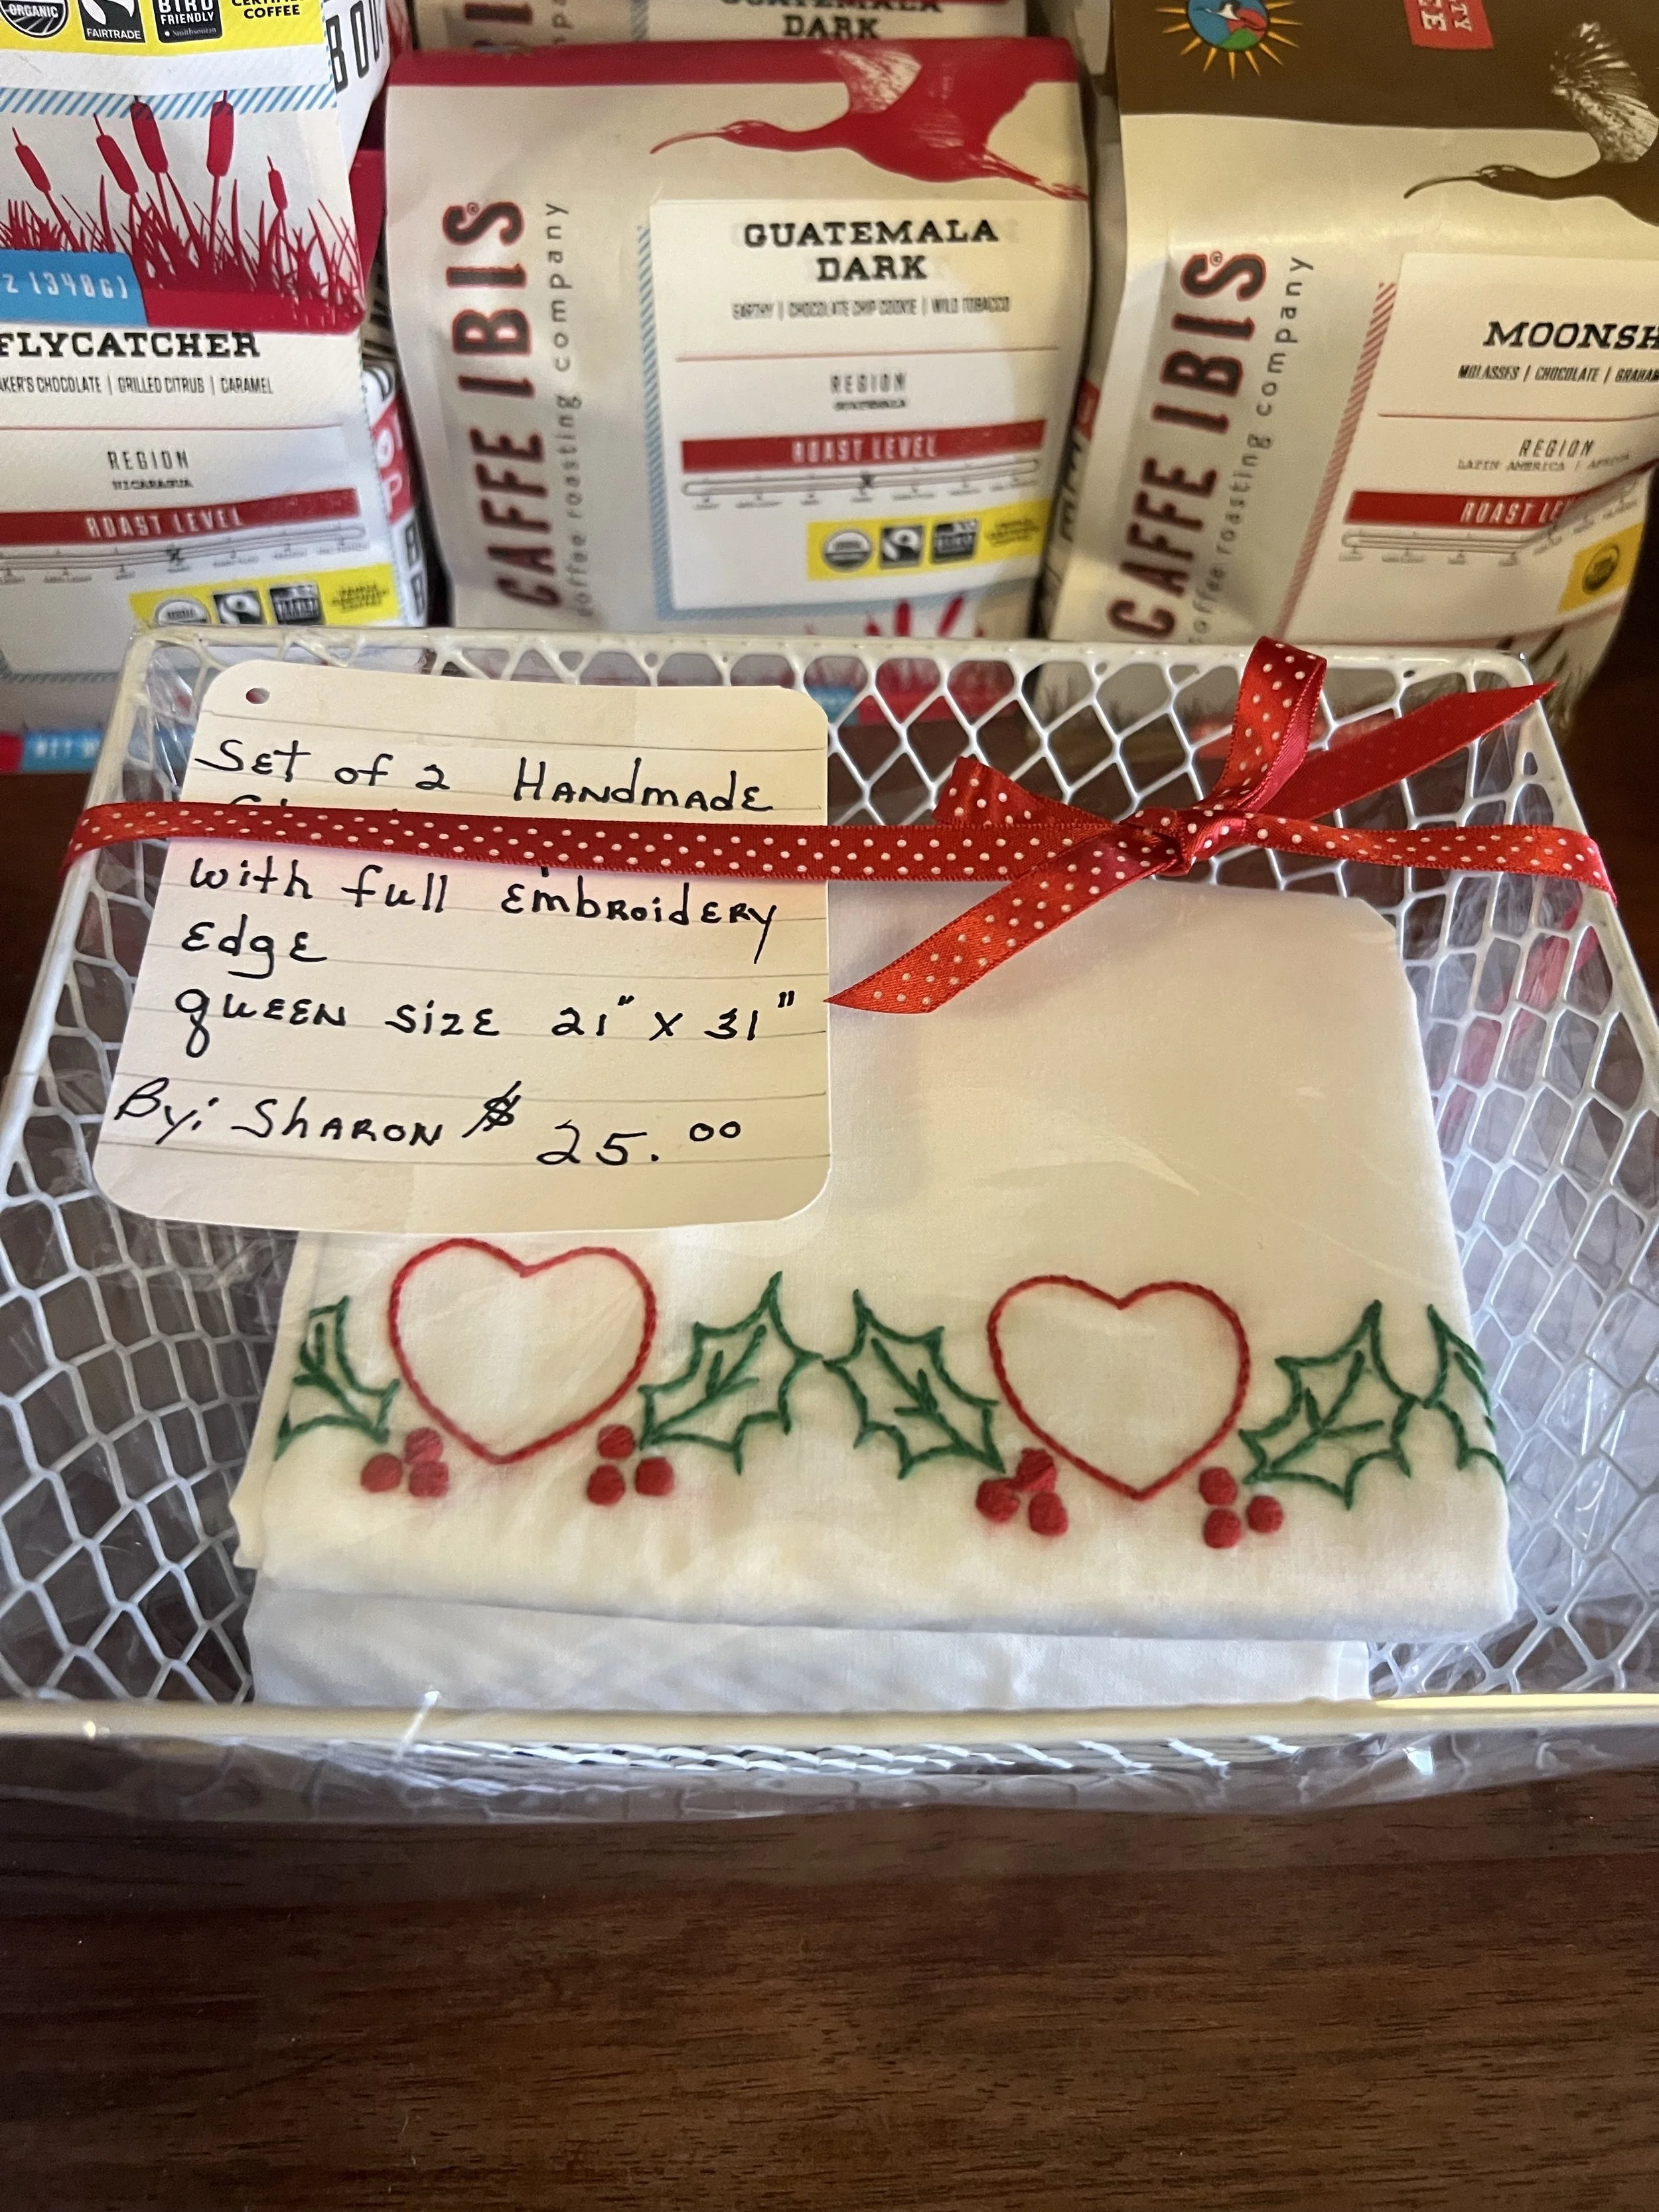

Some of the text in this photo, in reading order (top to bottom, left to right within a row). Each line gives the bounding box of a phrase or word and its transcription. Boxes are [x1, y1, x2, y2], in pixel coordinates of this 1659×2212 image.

[8, 3, 59, 18] ORGANIC
[160, 11, 214, 25] FRIENDLY
[244, 5, 300, 19] COFFEE
[87, 28, 141, 40] FAIRTRADE
[782, 14, 880, 38] DARK
[744, 219, 998, 248] GUATEMALA
[816, 255, 927, 282] DARK
[545, 202, 582, 372] company
[0, 331, 260, 358] FLYCATCHER
[36, 376, 102, 394] CHOCOLATE
[118, 376, 163, 394] GRILLED
[165, 376, 204, 394] CITRUS
[220, 377, 274, 395] CARAMEL
[830, 373, 906, 394] REGION
[1216, 433, 1273, 555] roasting
[1256, 256, 1313, 417] company
[107, 450, 189, 470] REGION
[555, 395, 584, 519] roasting
[792, 435, 936, 464] ROAST LEVEL
[1518, 439, 1593, 458] REGION
[86, 506, 242, 538] ROAST LEVEL
[469, 425, 564, 611] CAFFE
[1461, 502, 1534, 525] ROAST
[1106, 457, 1218, 641] CAFFE
[335, 753, 394, 786] of
[415, 764, 451, 790] 2
[190, 855, 313, 900] with
[341, 864, 447, 913] full
